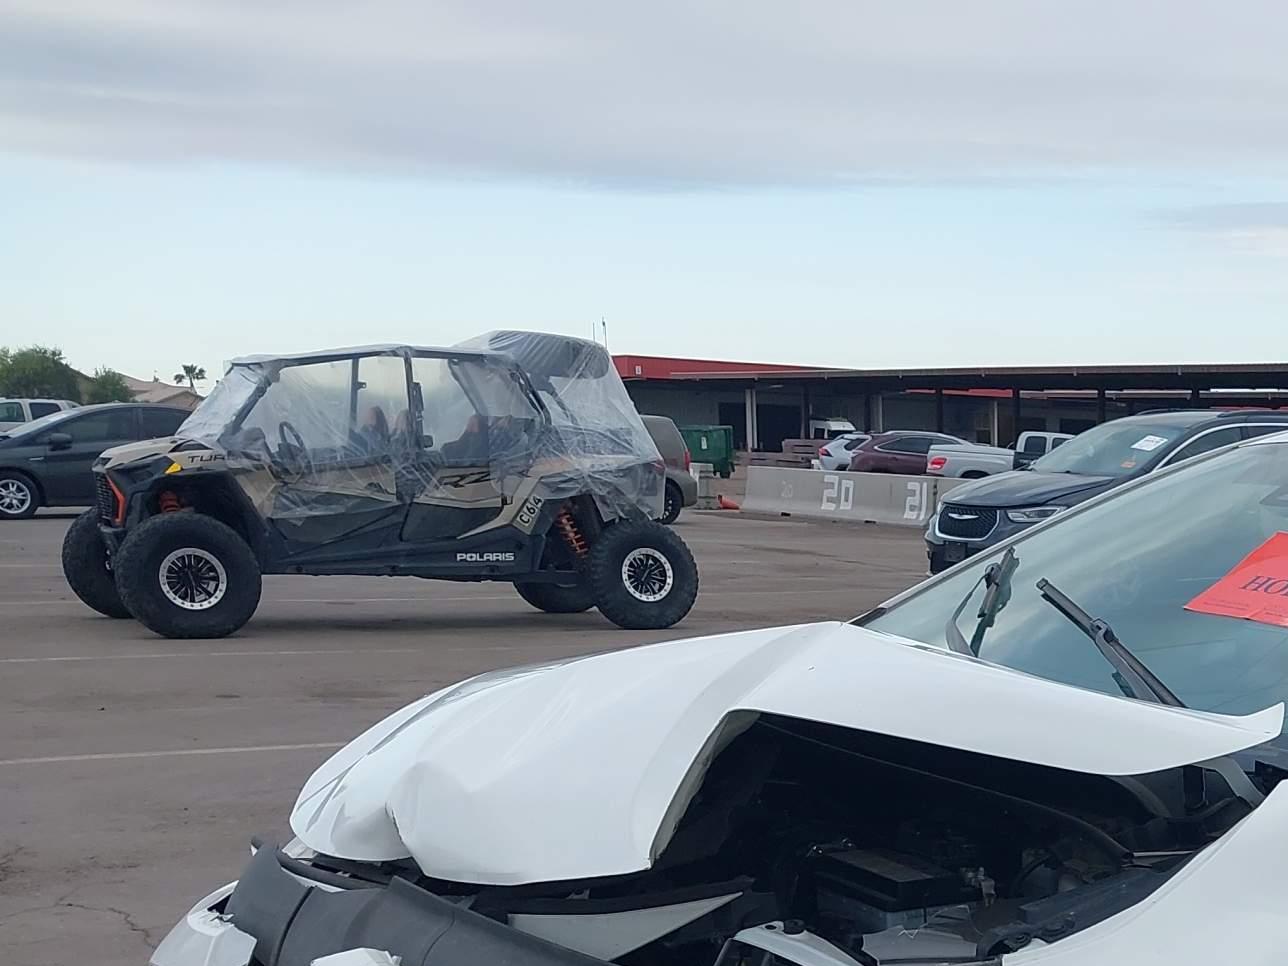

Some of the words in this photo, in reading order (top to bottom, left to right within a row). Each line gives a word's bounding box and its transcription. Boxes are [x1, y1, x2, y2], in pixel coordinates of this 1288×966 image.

[821, 475, 854, 511] 20
[904, 481, 928, 520] 21
[519, 495, 543, 525] C64
[456, 552, 515, 561] POLARIS
